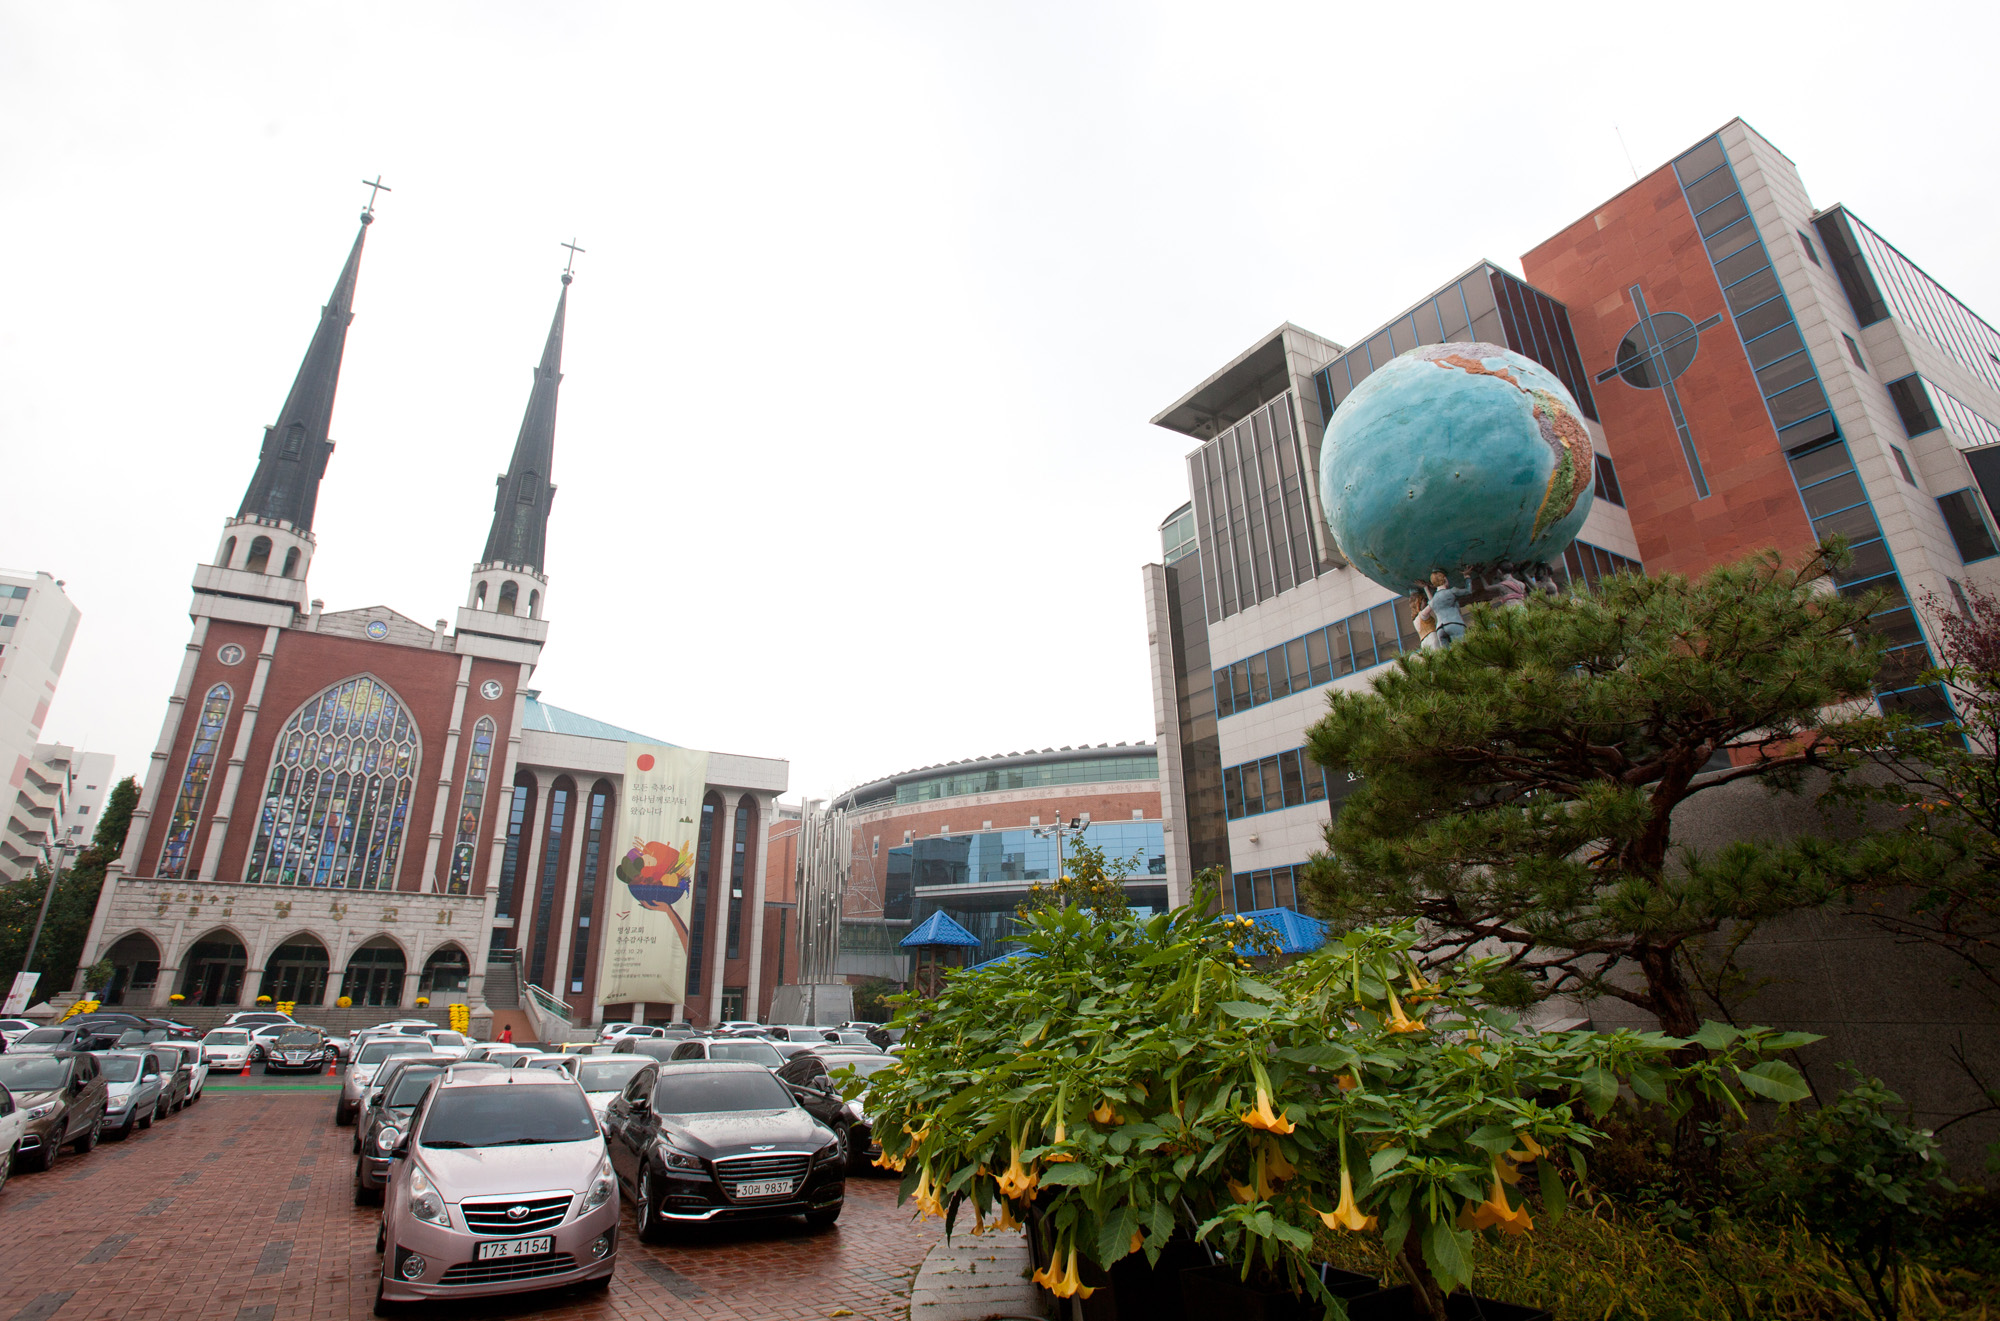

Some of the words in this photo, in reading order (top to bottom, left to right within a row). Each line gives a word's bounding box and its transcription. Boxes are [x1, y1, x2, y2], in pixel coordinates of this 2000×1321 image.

[632, 783, 648, 792] 모든
[651, 783, 675, 793] 축복이
[631, 794, 687, 806] 하나님께로부터
[630, 806, 663, 816] 왔습니다
[617, 926, 645, 934] 명성교회
[616, 936, 657, 944] 추수감사주일
[764, 1181, 788, 1194] 9837
[482, 1243, 508, 1258] 17조
[513, 1238, 549, 1254] 4154
